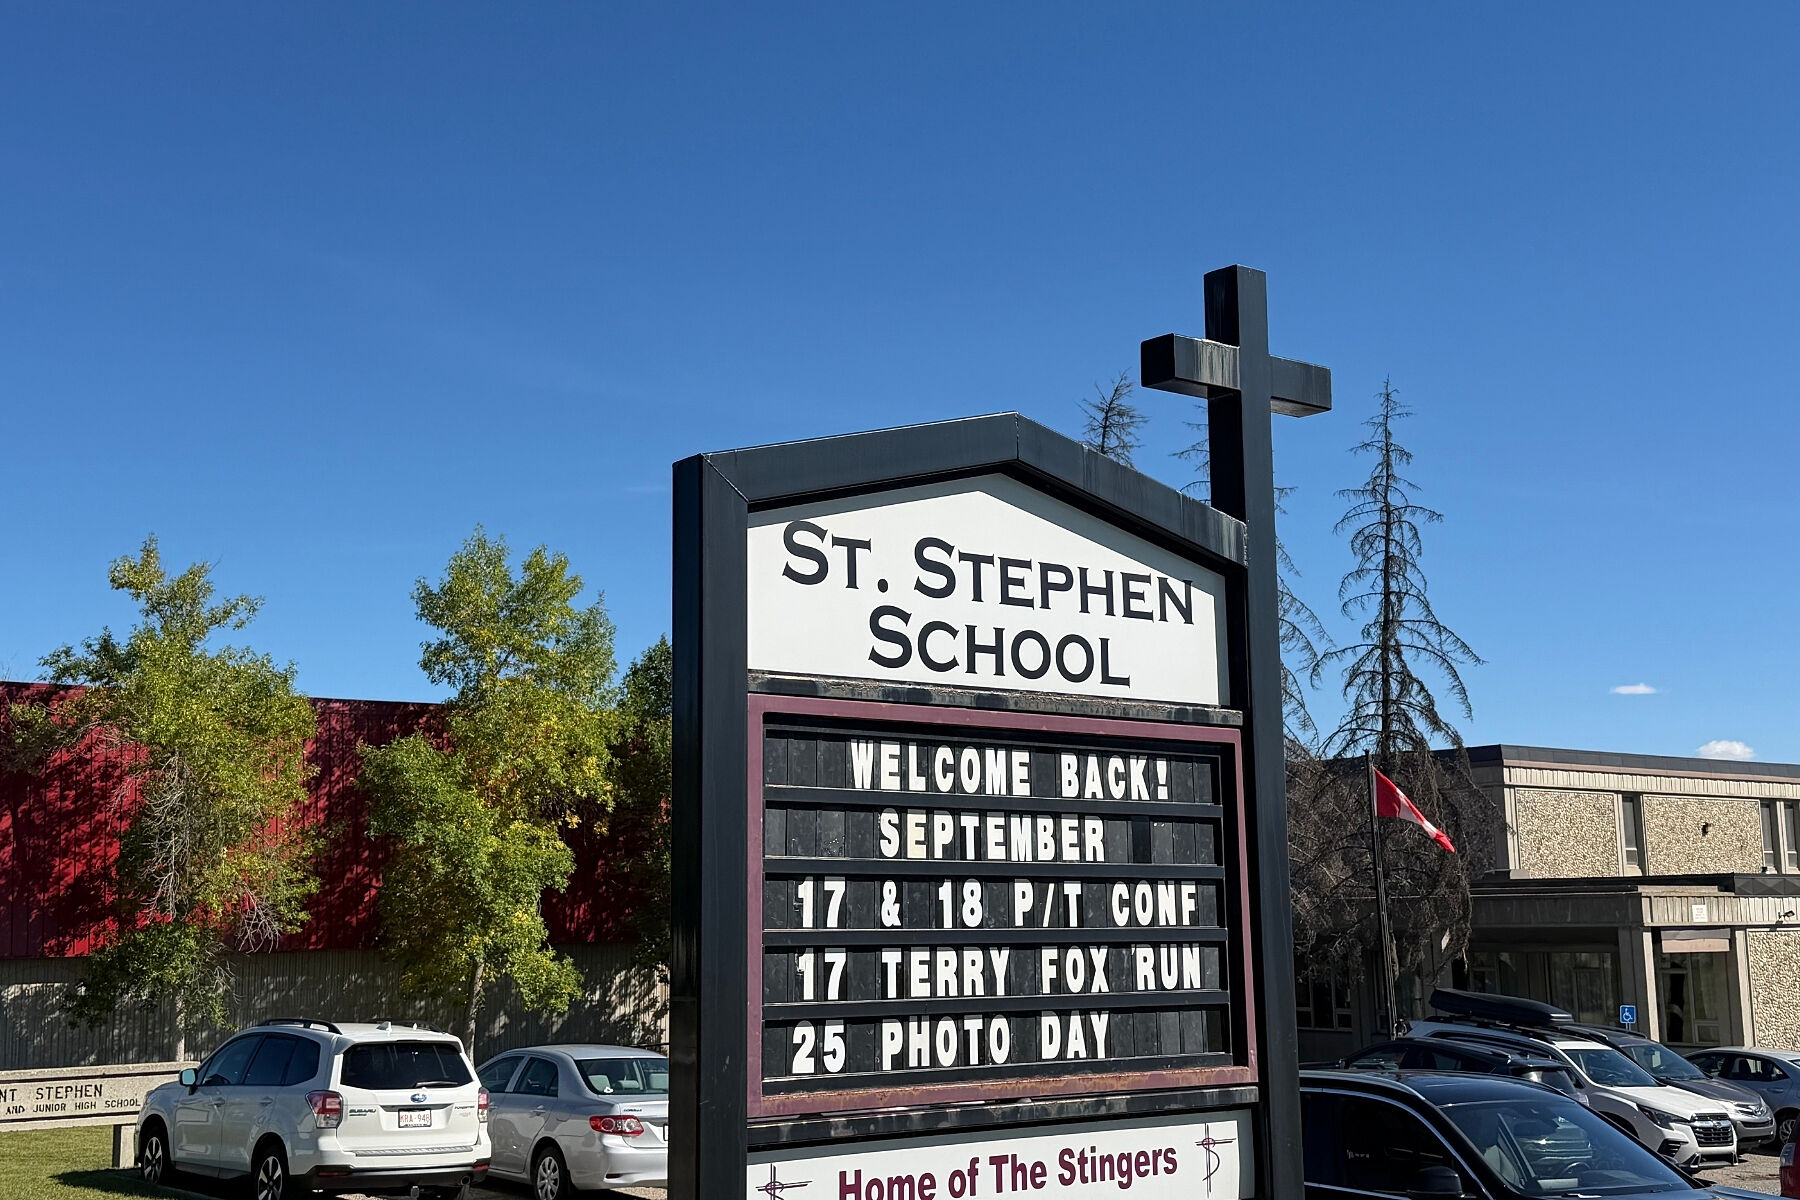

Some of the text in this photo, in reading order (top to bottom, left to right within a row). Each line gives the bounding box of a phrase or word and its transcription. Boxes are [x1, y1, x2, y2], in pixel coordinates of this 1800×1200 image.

[782, 520, 1195, 625] ST. STEPHEN
[868, 605, 1131, 688] SCHOOL
[850, 740, 1169, 800] WELCOME BACK!
[880, 808, 1105, 862] SEPTEMBER
[798, 876, 1196, 929] 17 & 18 P/T CONF
[797, 947, 847, 1000] 17
[882, 947, 1010, 999] TERRY
[1042, 946, 1110, 993] FOX
[792, 1011, 1109, 1073] 25 PHOTO DAY
[6, 1099, 141, 1115] AND JUNIOR HIGH SCHOOL
[36, 1084, 103, 1100] STEPHEN
[838, 1146, 1178, 1200] Home of The Stingers
